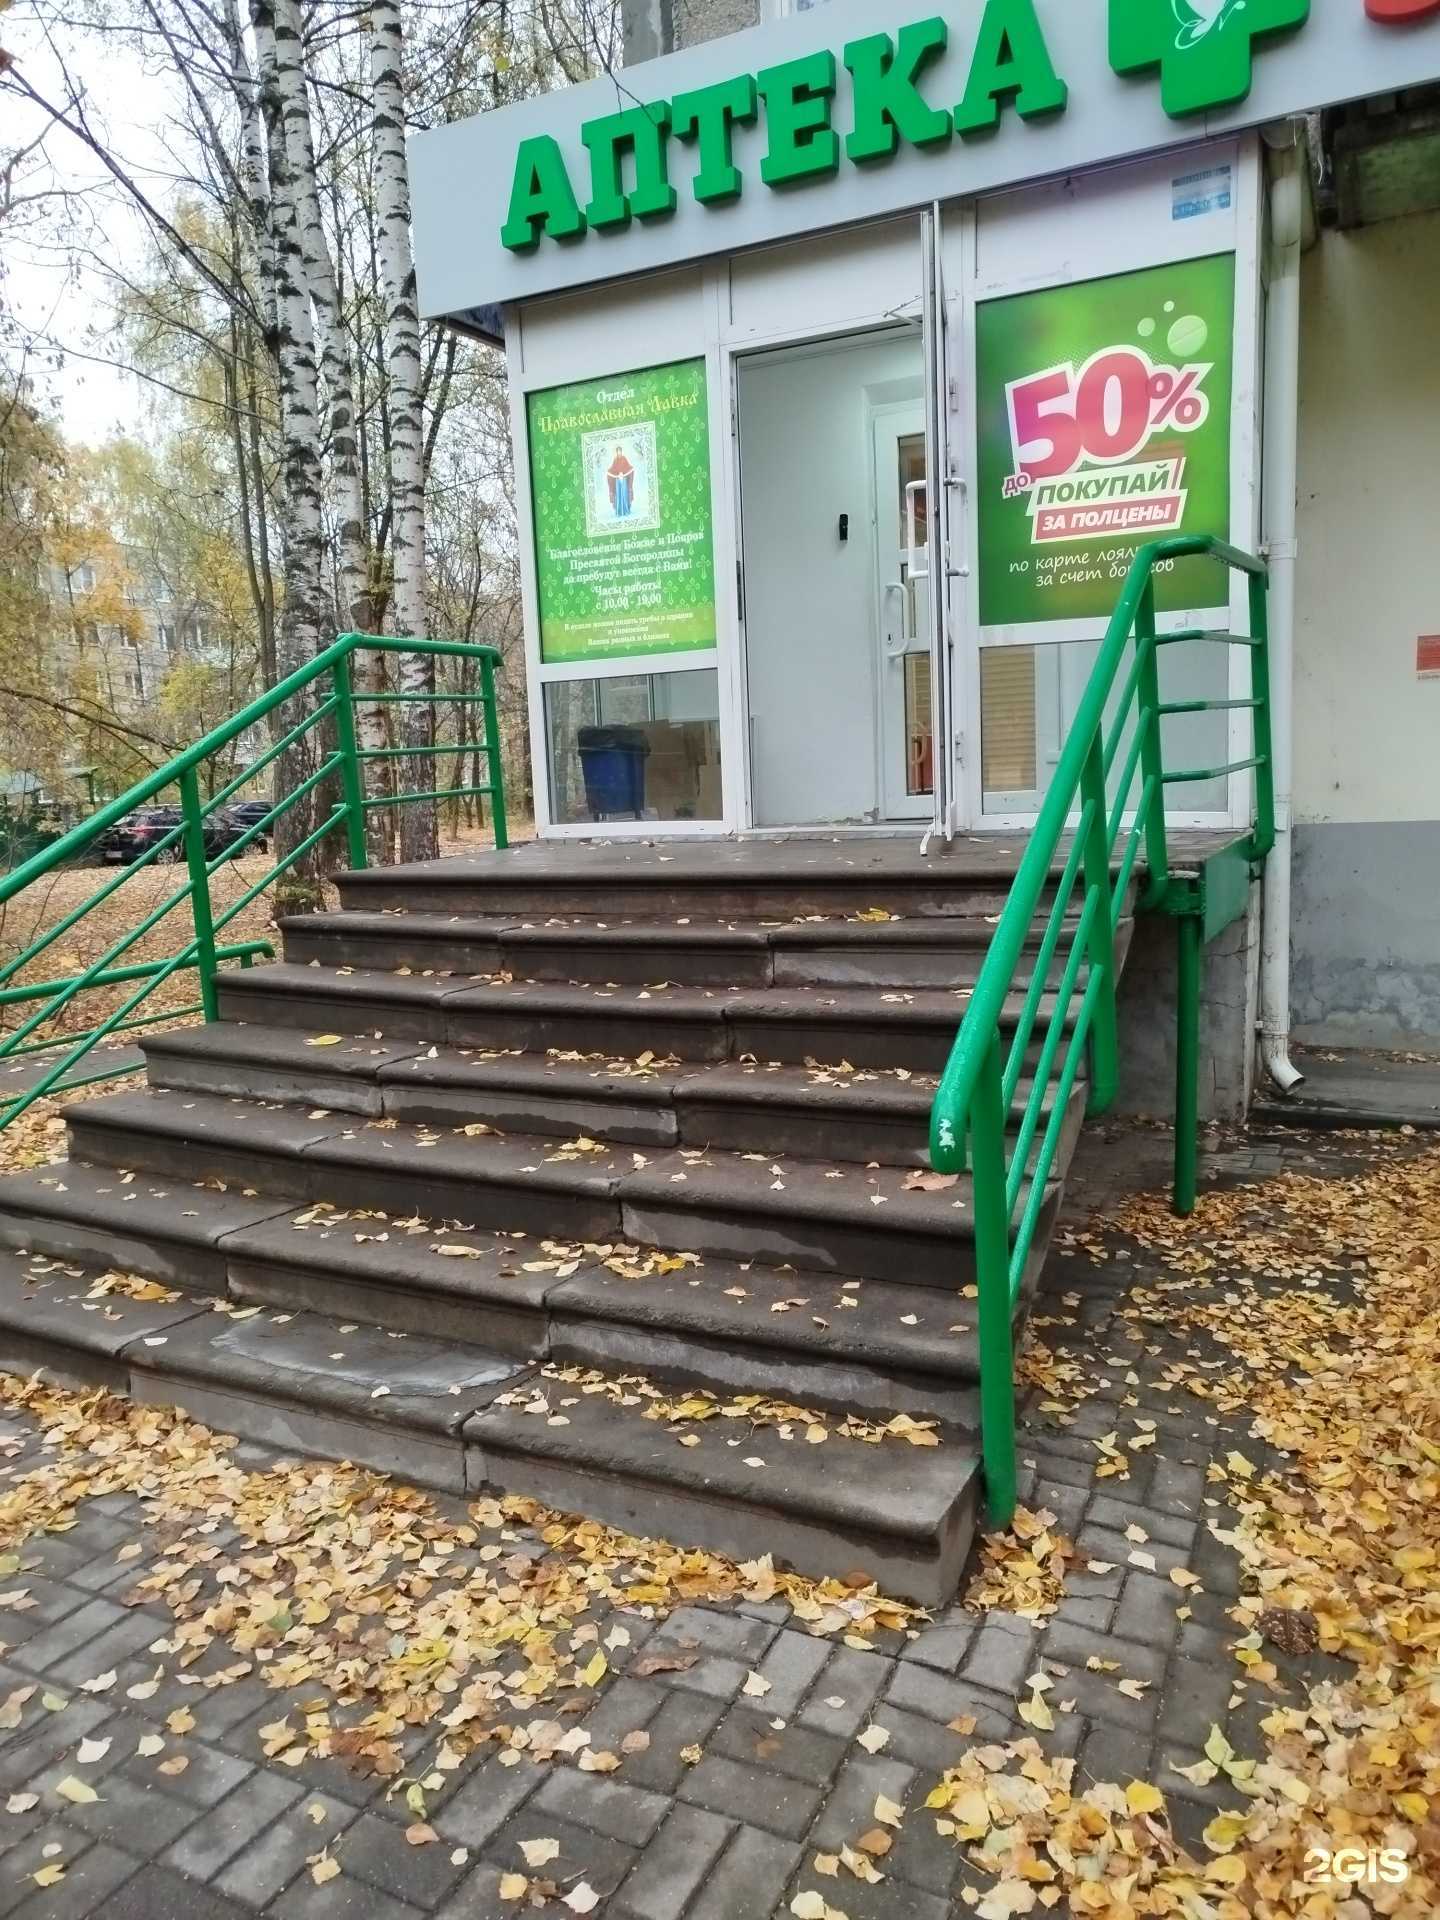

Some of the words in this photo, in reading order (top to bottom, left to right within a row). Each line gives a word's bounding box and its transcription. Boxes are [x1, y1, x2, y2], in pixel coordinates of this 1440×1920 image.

[499, 0, 1068, 251] АПТЕКА
[596, 387, 635, 404] Отдел
[538, 402, 645, 433] Православная
[647, 391, 700, 412] Лавка
[1010, 350, 1205, 478] 50%
[1036, 463, 1171, 506] ПОКУПАЙ
[1042, 514, 1066, 532] ЗА
[1070, 503, 1172, 529] ПОЛЦЕНЫ
[550, 542, 622, 561] Благословение
[623, 536, 656, 550] Божие
[658, 536, 665, 545] и
[667, 531, 705, 546] Покров
[570, 554, 621, 571] Пресвятой
[622, 548, 685, 565] Богородицы
[563, 575, 576, 585] да
[576, 569, 620, 585] пребудут
[622, 565, 655, 578] всегда
[662, 559, 693, 574] Вами!
[1008, 559, 1029, 573] по
[1035, 551, 1090, 576] карте
[1035, 572, 1053, 588] за
[1059, 565, 1102, 585] счет
[593, 584, 623, 597] Часы
